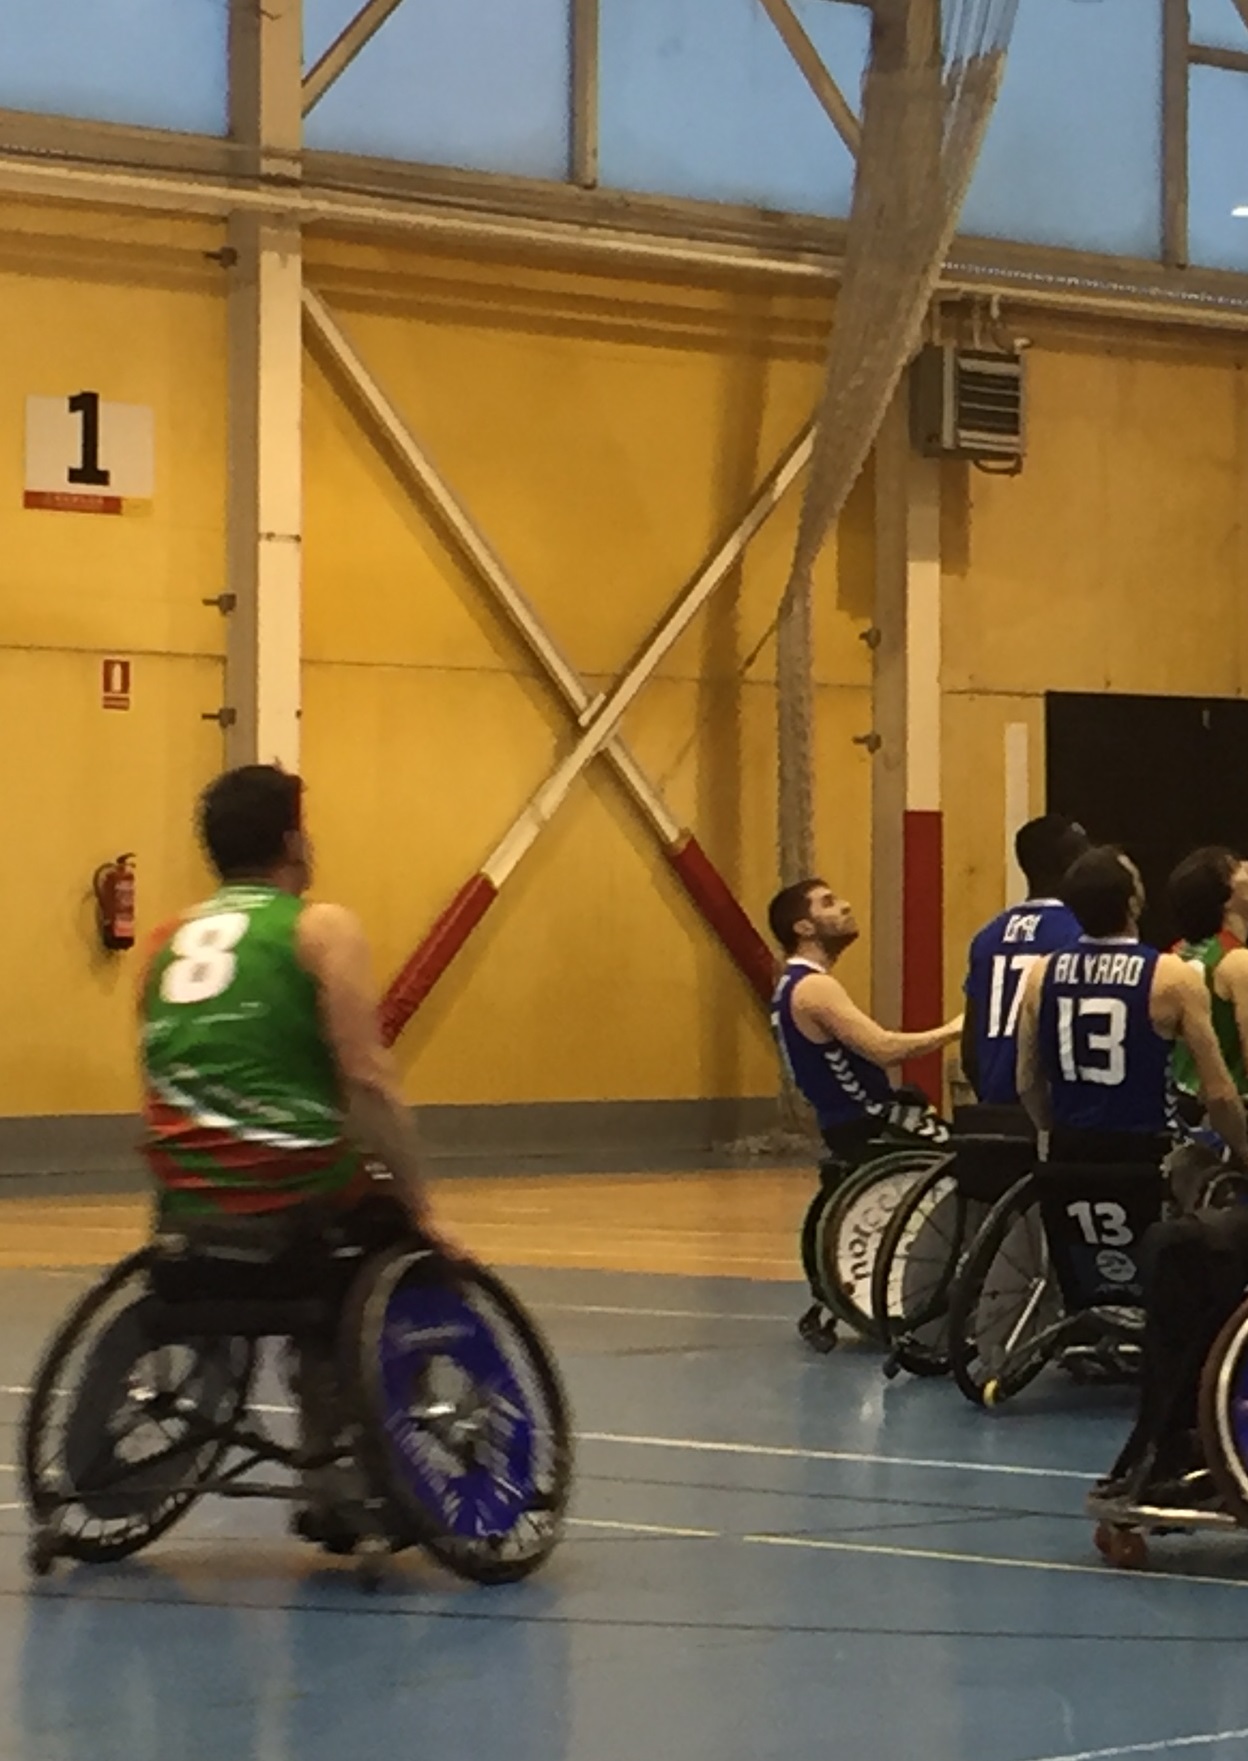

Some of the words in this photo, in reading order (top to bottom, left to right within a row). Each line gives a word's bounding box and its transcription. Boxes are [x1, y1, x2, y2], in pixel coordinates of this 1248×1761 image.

[67, 391, 110, 486] 1
[159, 912, 250, 1004] 8
[988, 955, 1041, 1038] 17
[1053, 953, 1146, 986] ALVARO
[1056, 996, 1127, 1086] 13
[1067, 1200, 1133, 1246] 13
